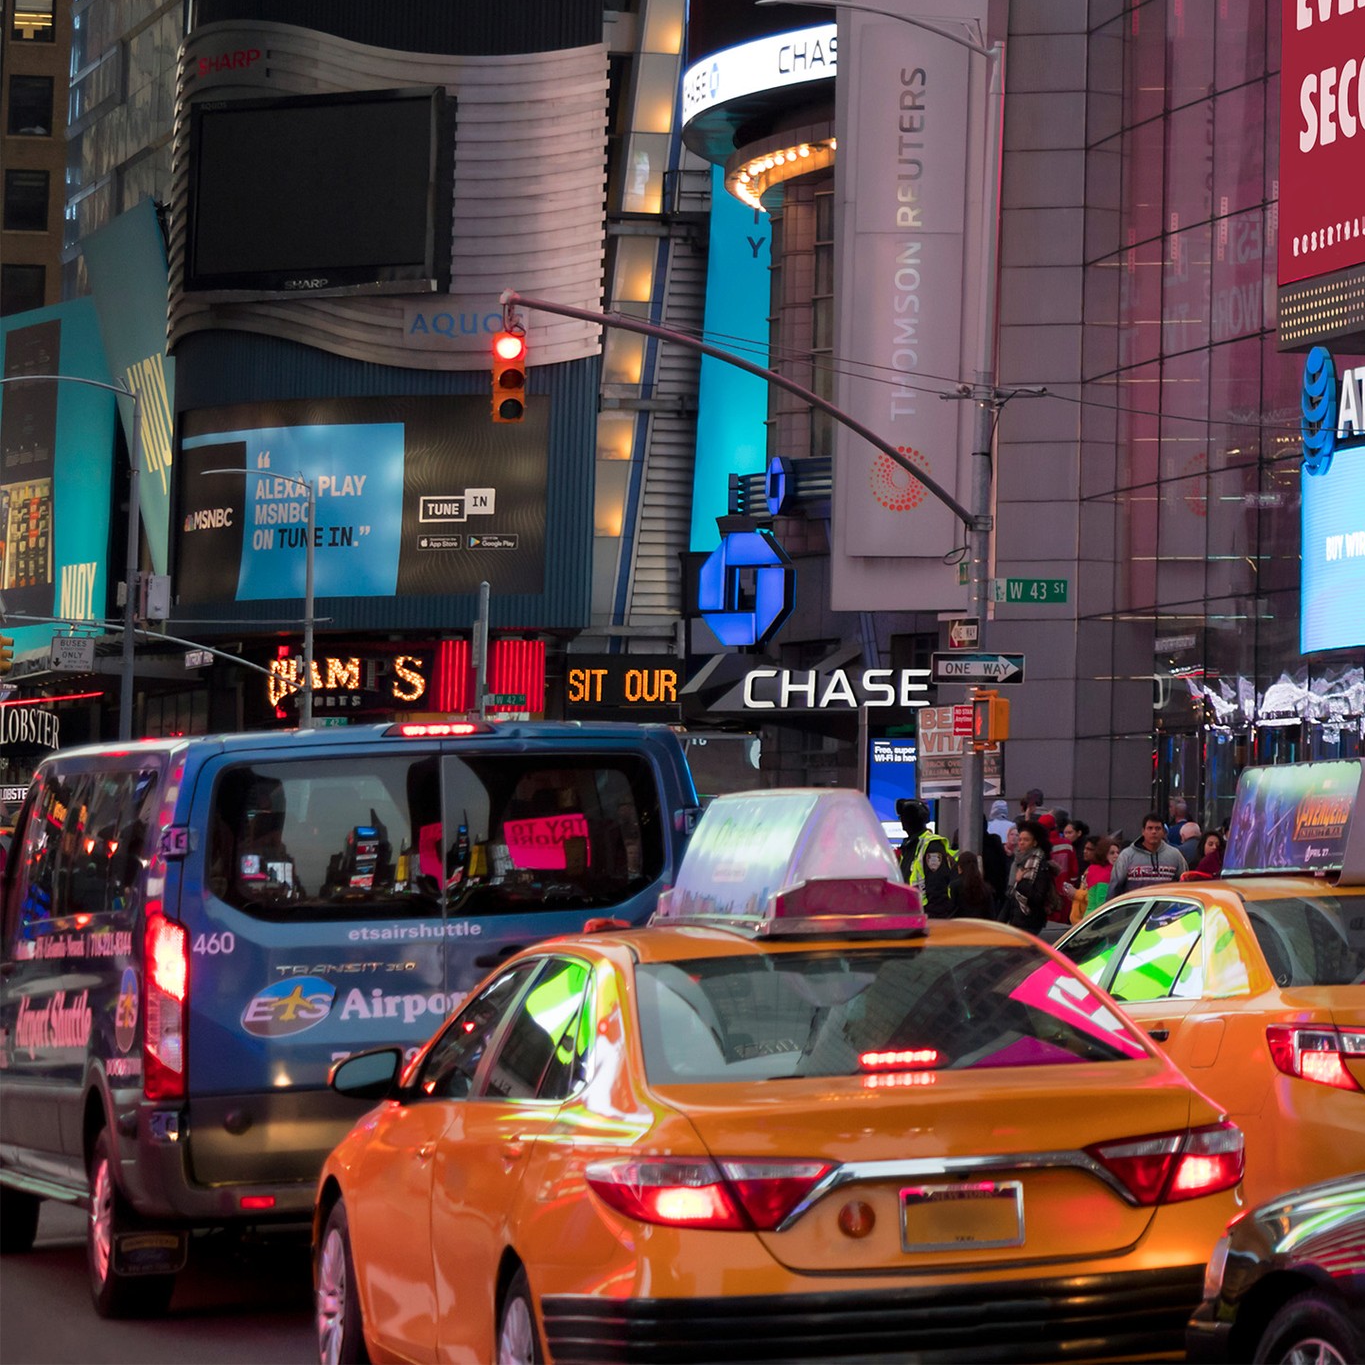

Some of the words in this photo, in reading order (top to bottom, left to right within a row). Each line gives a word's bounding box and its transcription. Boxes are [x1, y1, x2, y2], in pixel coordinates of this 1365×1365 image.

[198, 48, 262, 79] SHARP
[895, 66, 927, 229] REUTERS
[284, 277, 330, 290] SHARP
[890, 239, 922, 423] THOMSON
[318, 474, 367, 497] PLAY
[254, 501, 311, 525] MSNBC
[427, 503, 460, 515] TUNE
[472, 495, 488, 507] IN
[193, 507, 233, 531] MSNBC
[252, 528, 274, 550] ON
[277, 526, 323, 549] TUNE
[429, 540, 442, 548] App
[481, 540, 503, 548] Google
[502, 540, 515, 548] Play
[1325, 534, 1343, 562] BUY
[1010, 582, 1024, 599] W
[1030, 582, 1048, 600] 43
[1053, 581, 1065, 594] St
[953, 627, 963, 639] ONE
[965, 626, 977, 639] WAY
[60, 638, 87, 648] BUSES
[62, 650, 84, 660] ONLY
[945, 662, 971, 675] ONE
[983, 662, 1010, 676] WAY
[568, 668, 609, 702] SIT
[624, 668, 678, 702] OUR
[741, 669, 932, 710] CHASE
[496, 695, 504, 705] W
[506, 694, 517, 705] 42
[0, 704, 60, 752] LOBSTER
[874, 746, 893, 756] Free,
[874, 753, 894, 763] Wi-Fi
[895, 753, 903, 763] is
[348, 921, 482, 942] etsairshuttle
[192, 931, 236, 956] 460
[275, 962, 384, 976] TRANSIT
